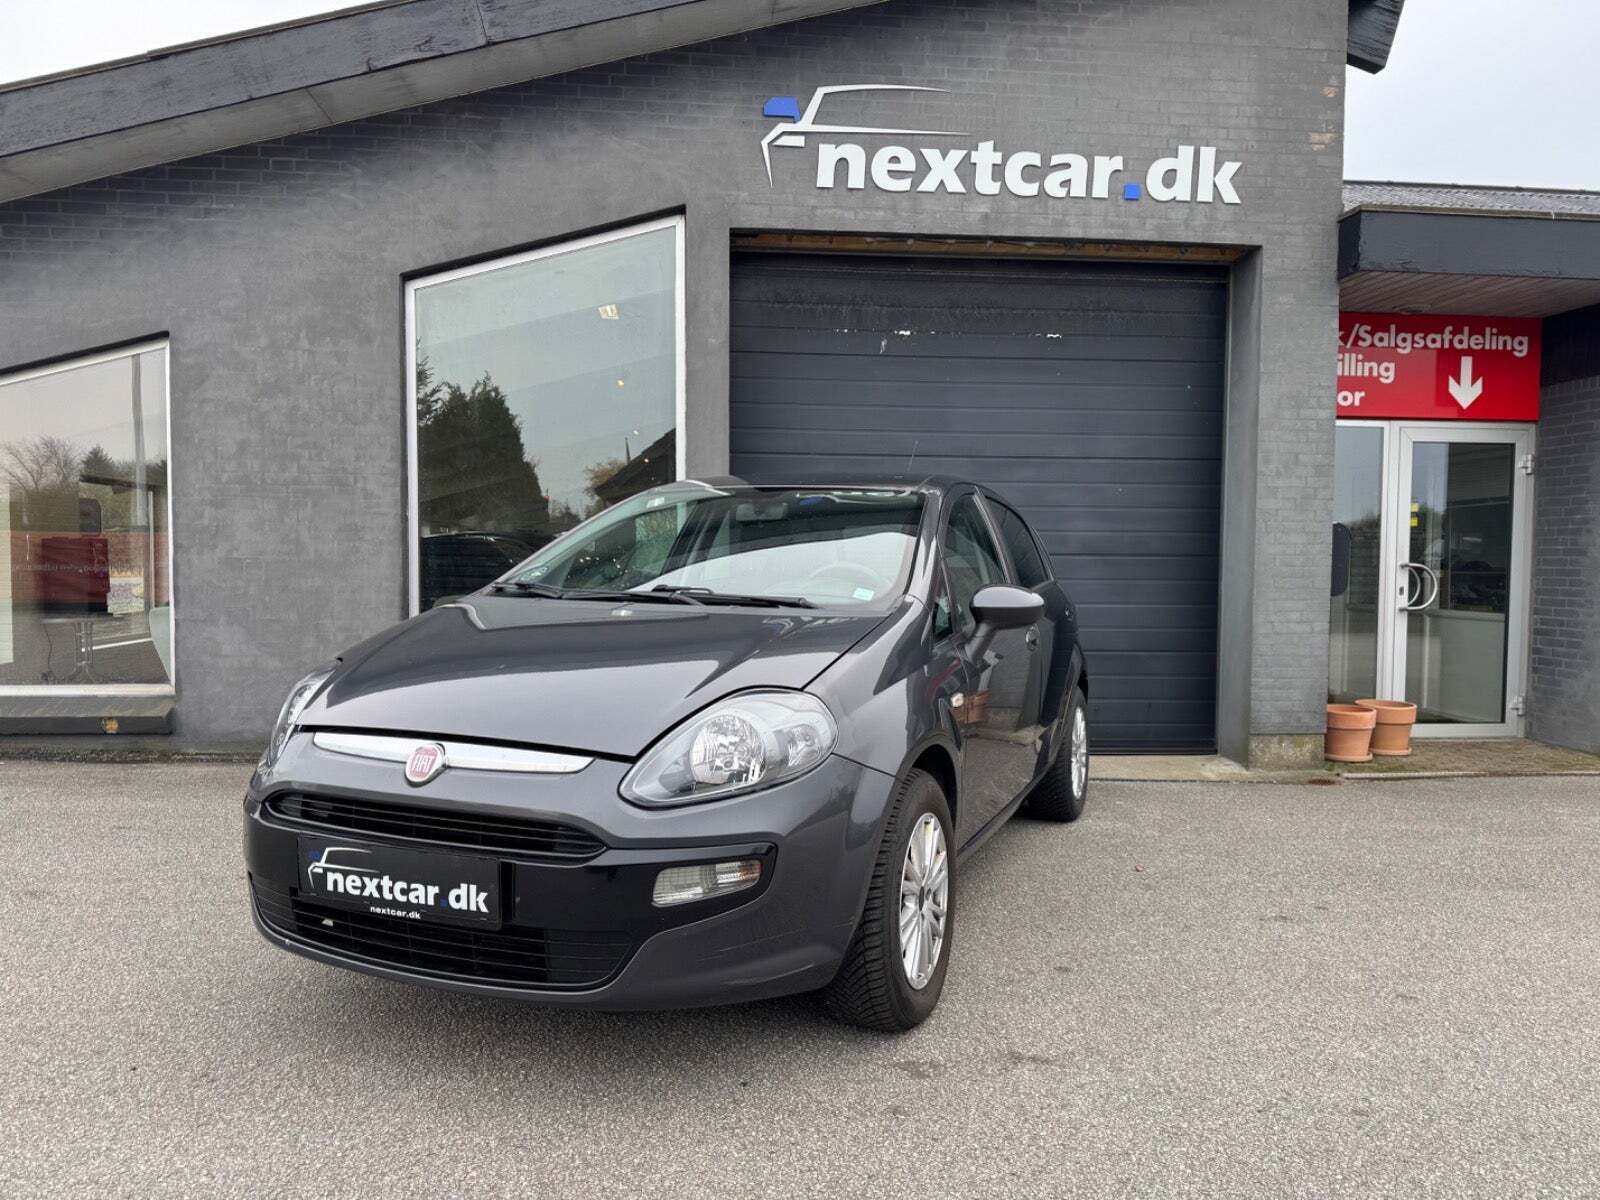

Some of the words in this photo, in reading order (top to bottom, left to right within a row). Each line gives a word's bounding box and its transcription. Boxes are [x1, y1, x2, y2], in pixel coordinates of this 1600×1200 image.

[816, 139, 1243, 205] nextcar.dk
[1337, 390, 1366, 407] or
[412, 753, 436, 773] FIAT
[326, 871, 489, 914] nextcar.dk
[370, 905, 422, 920] nextcar.dk
